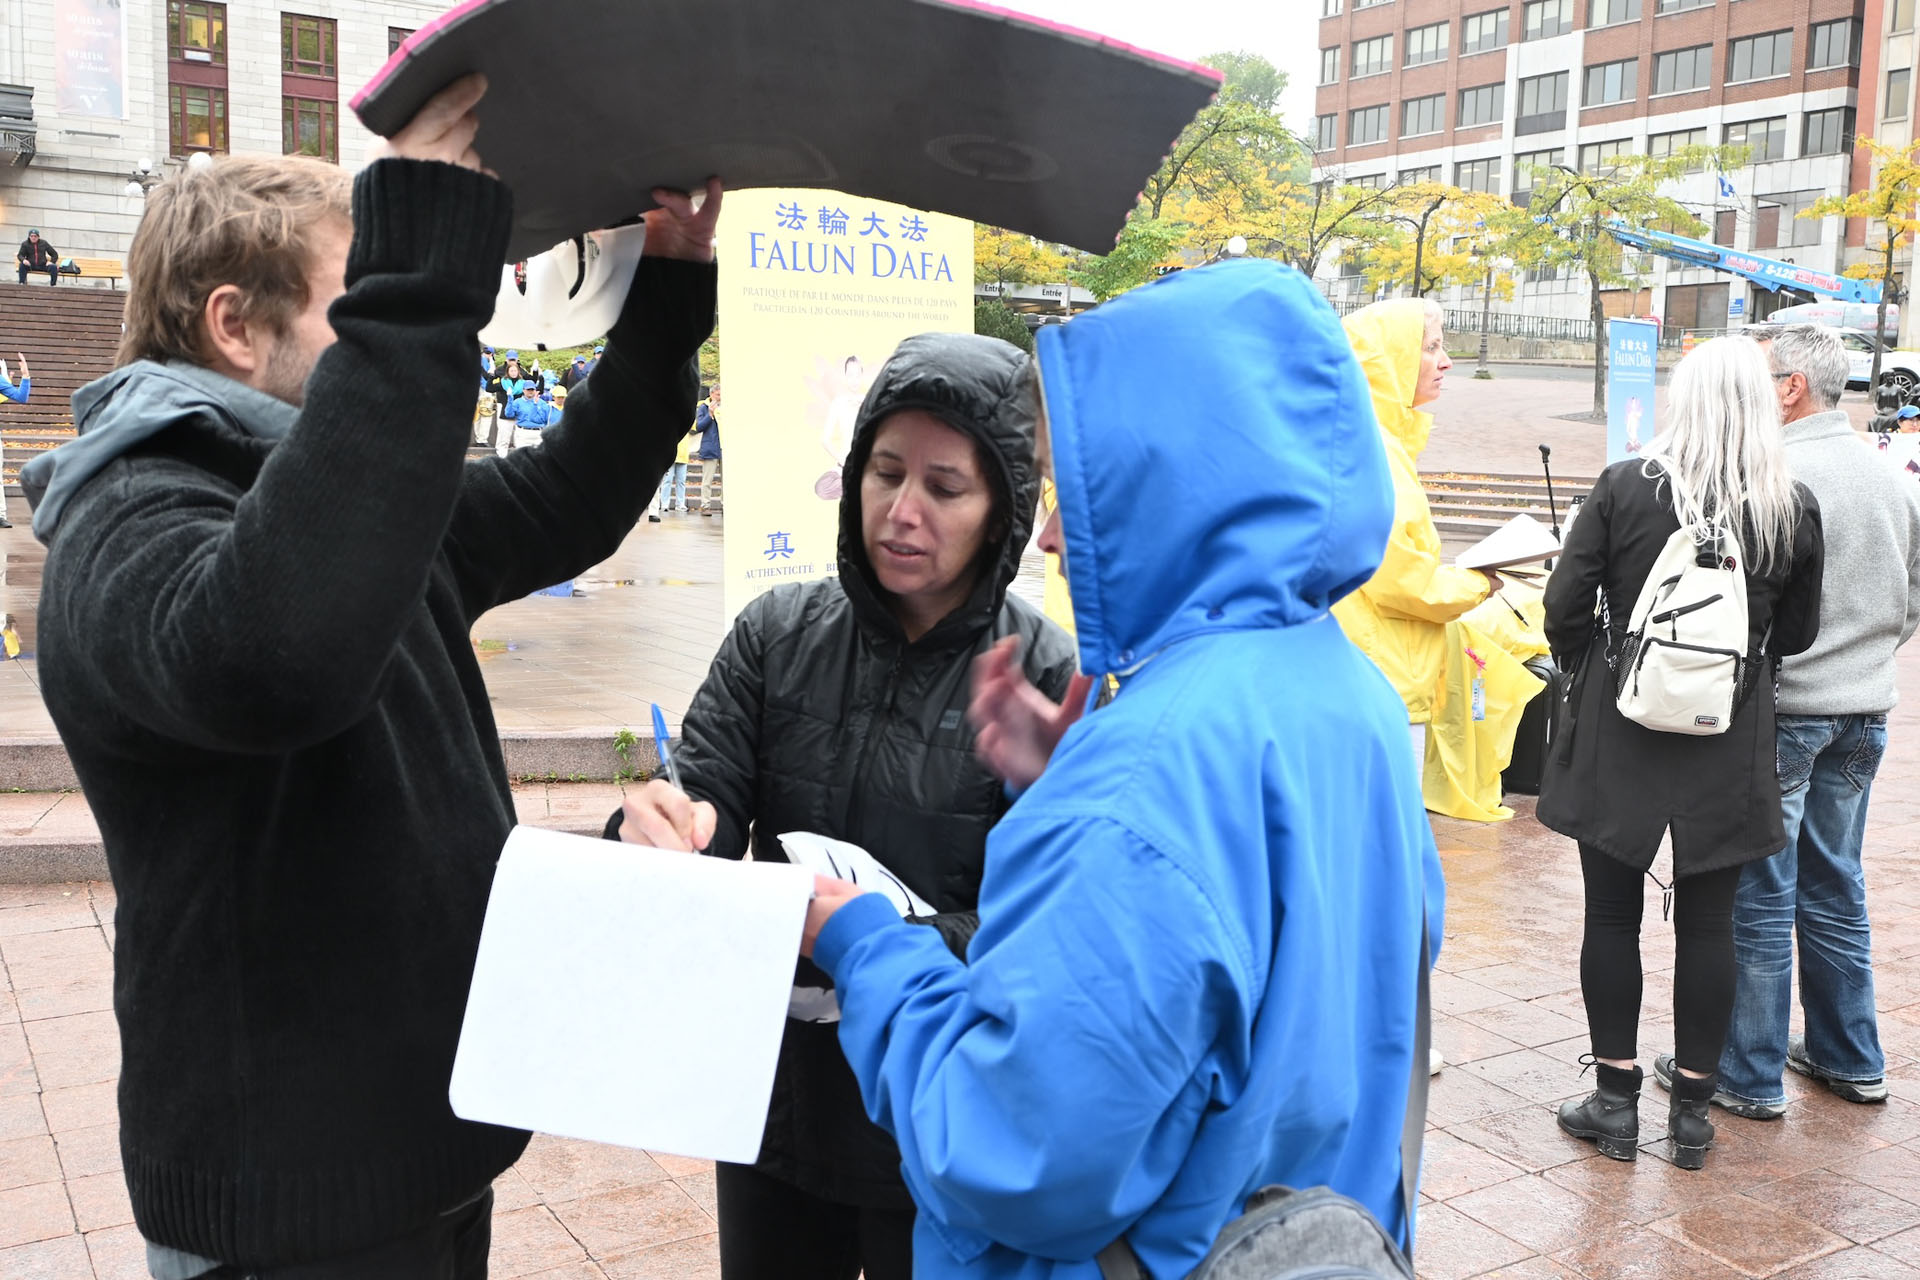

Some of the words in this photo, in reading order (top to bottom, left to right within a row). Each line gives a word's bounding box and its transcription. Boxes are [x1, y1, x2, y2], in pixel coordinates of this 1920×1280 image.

[775, 201, 929, 243] 法輪大法
[748, 231, 855, 276] FALUN
[871, 242, 954, 283] DAFA
[831, 291, 864, 304] MONDE
[867, 294, 890, 305] DANS
[891, 295, 912, 305] PLUS
[1041, 288, 1062, 297] Entrée
[763, 531, 795, 561] 真
[744, 562, 815, 579] AUTHENTICITÉ
